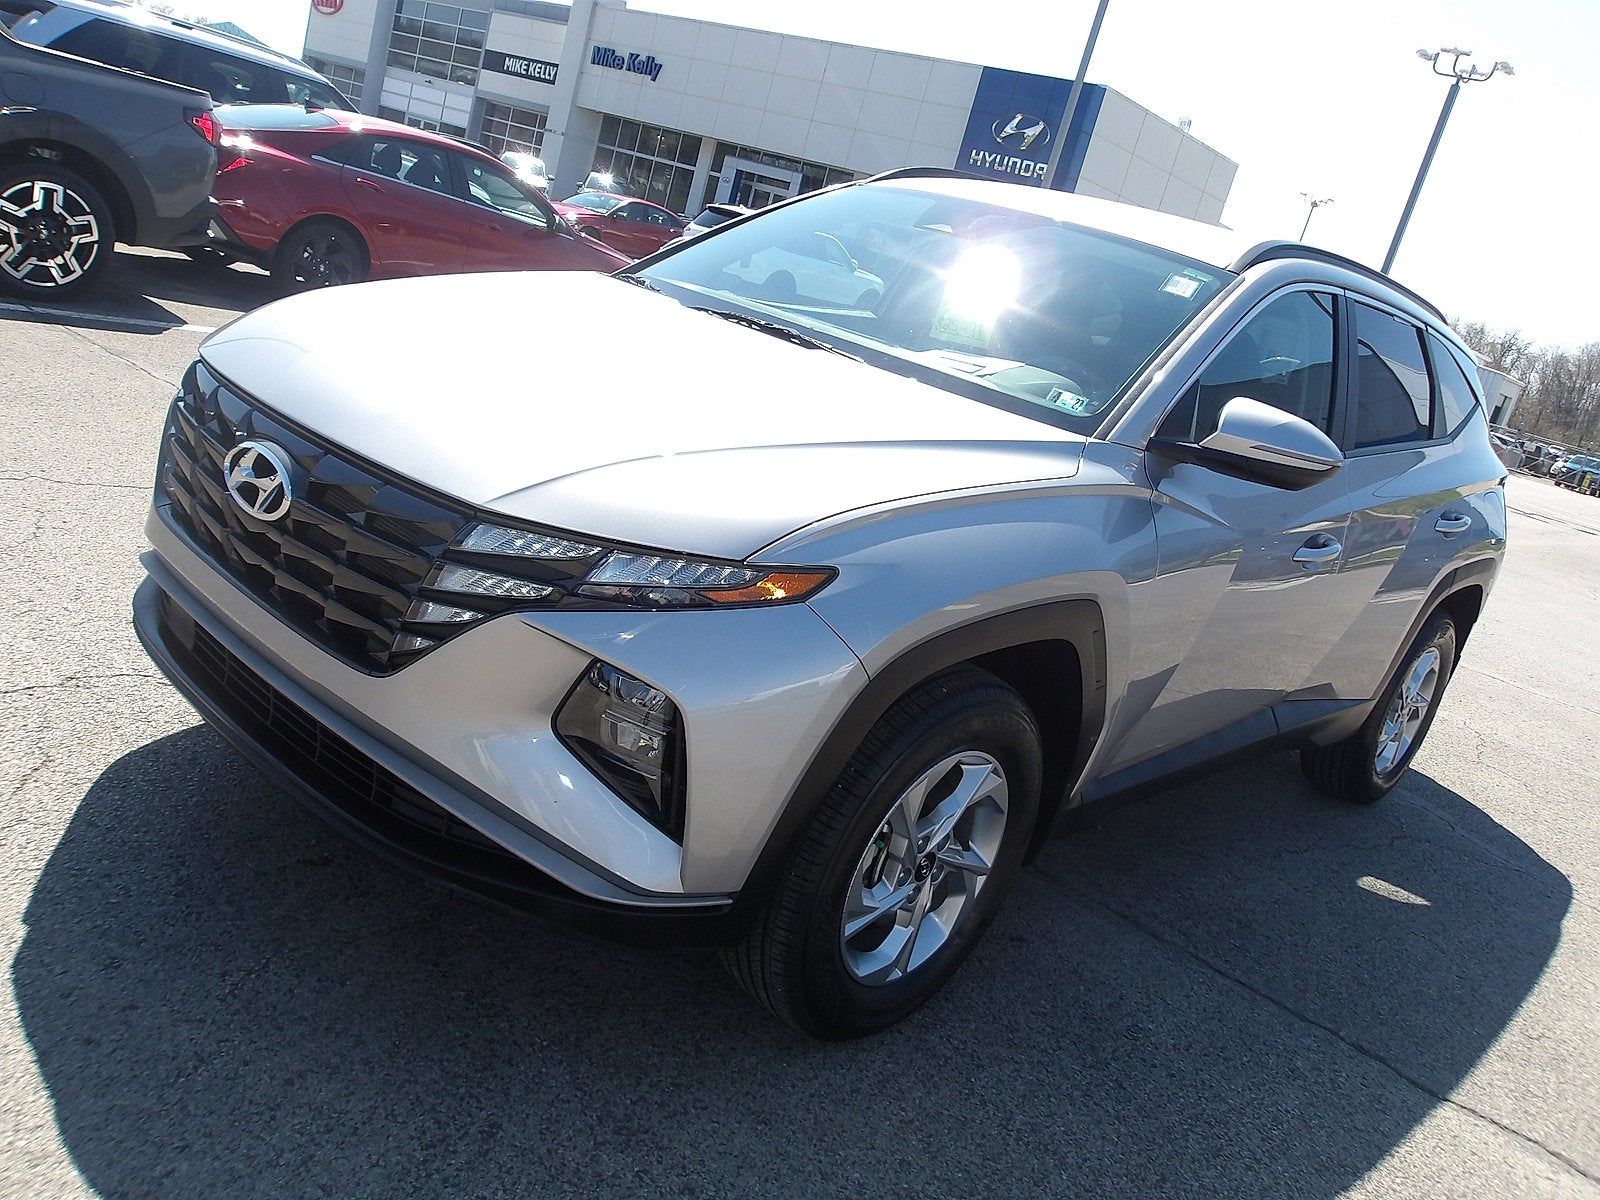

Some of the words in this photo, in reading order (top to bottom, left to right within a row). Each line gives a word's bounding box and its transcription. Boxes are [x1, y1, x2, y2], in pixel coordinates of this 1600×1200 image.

[504, 56, 529, 75] MIKE
[528, 61, 557, 81] KELLY
[590, 46, 624, 71] Mike
[625, 52, 662, 82] Kelly
[968, 149, 1048, 180] HYUNDA
